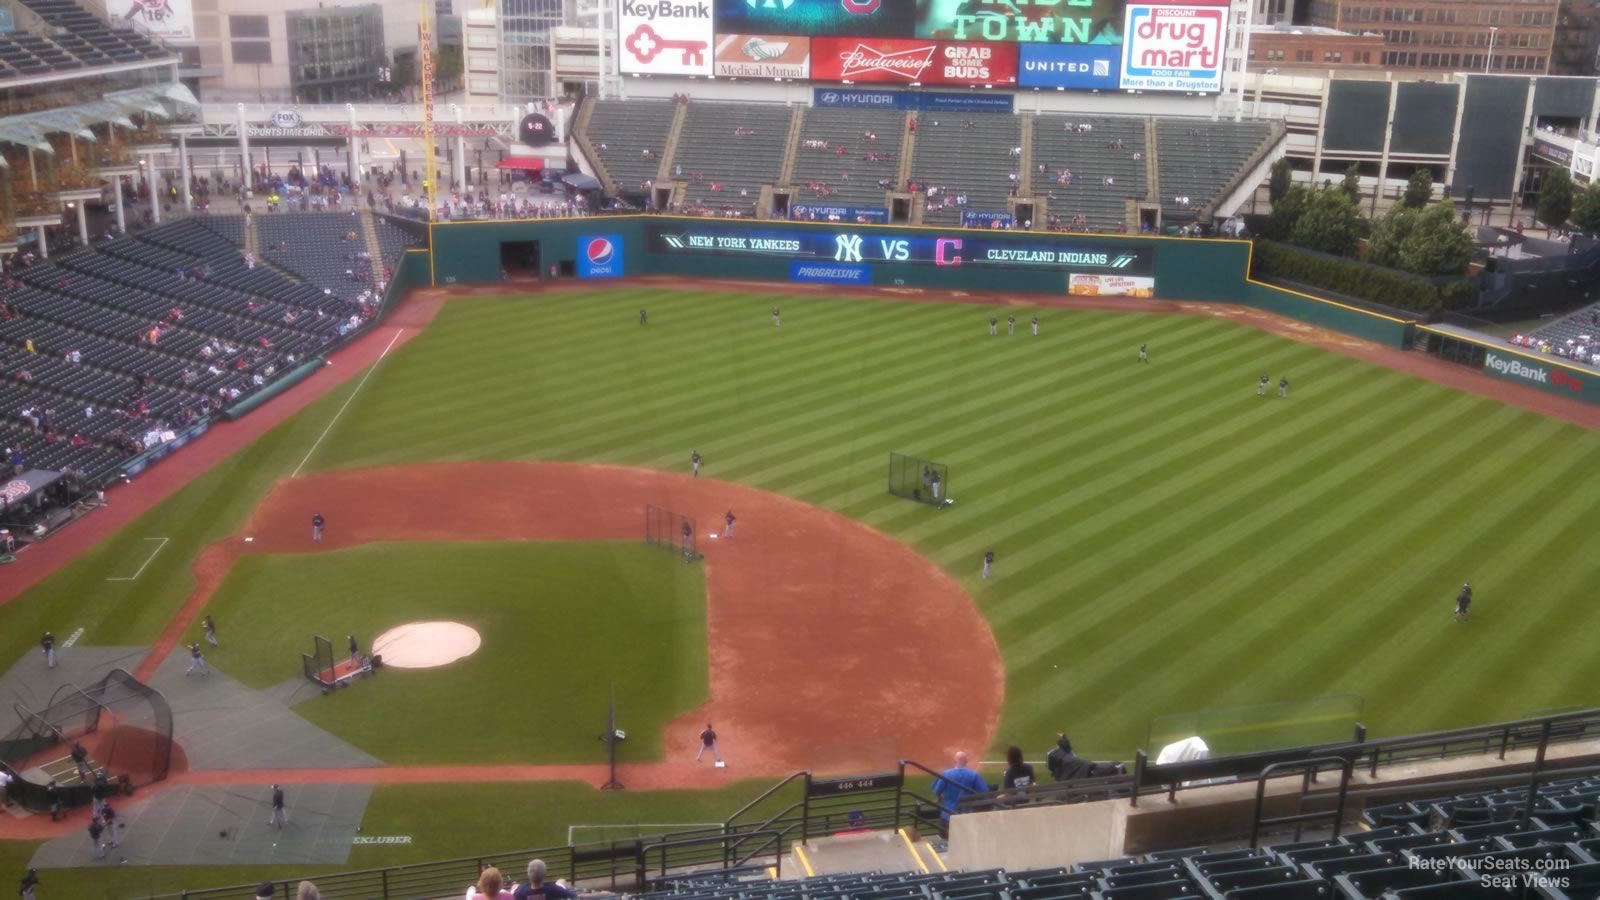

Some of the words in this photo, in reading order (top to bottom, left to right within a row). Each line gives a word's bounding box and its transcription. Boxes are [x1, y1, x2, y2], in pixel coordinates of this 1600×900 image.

[148, 9, 162, 21] 16
[622, 0, 709, 20] KeyBank
[1157, 9, 1196, 17] DISCOUNT
[953, 15, 1092, 43] TOWN
[1137, 19, 1205, 48] drug
[944, 46, 992, 60] GRAB
[1141, 46, 1216, 69] mart
[840, 52, 932, 69] Budweiser
[952, 58, 983, 67] SOME
[1025, 61, 1089, 73] UNITED
[421, 33, 433, 121] WALGREENS
[720, 64, 762, 76] Medical
[766, 66, 803, 77] Mutual
[944, 66, 990, 79] BUDS
[1151, 69, 1171, 77] FOOD
[1122, 77, 1144, 87] More
[1147, 78, 1166, 87] than
[1177, 79, 1218, 91] Drugstore
[842, 94, 893, 104] HYUNDAI
[277, 113, 295, 121] FOX
[808, 207, 847, 215] HYUNDAI
[689, 236, 713, 248] NEW
[717, 237, 746, 249] YORK
[750, 238, 800, 251] YANKEES
[881, 240, 910, 260] VS
[987, 249, 1055, 263] CLEVELAND
[1058, 252, 1108, 265] INDIANS
[590, 266, 612, 275] pepsi
[798, 266, 863, 280] PROGRESSIVE
[1485, 353, 1547, 382] KeyBank
[838, 782, 853, 790] 446
[857, 780, 873, 788] 444
